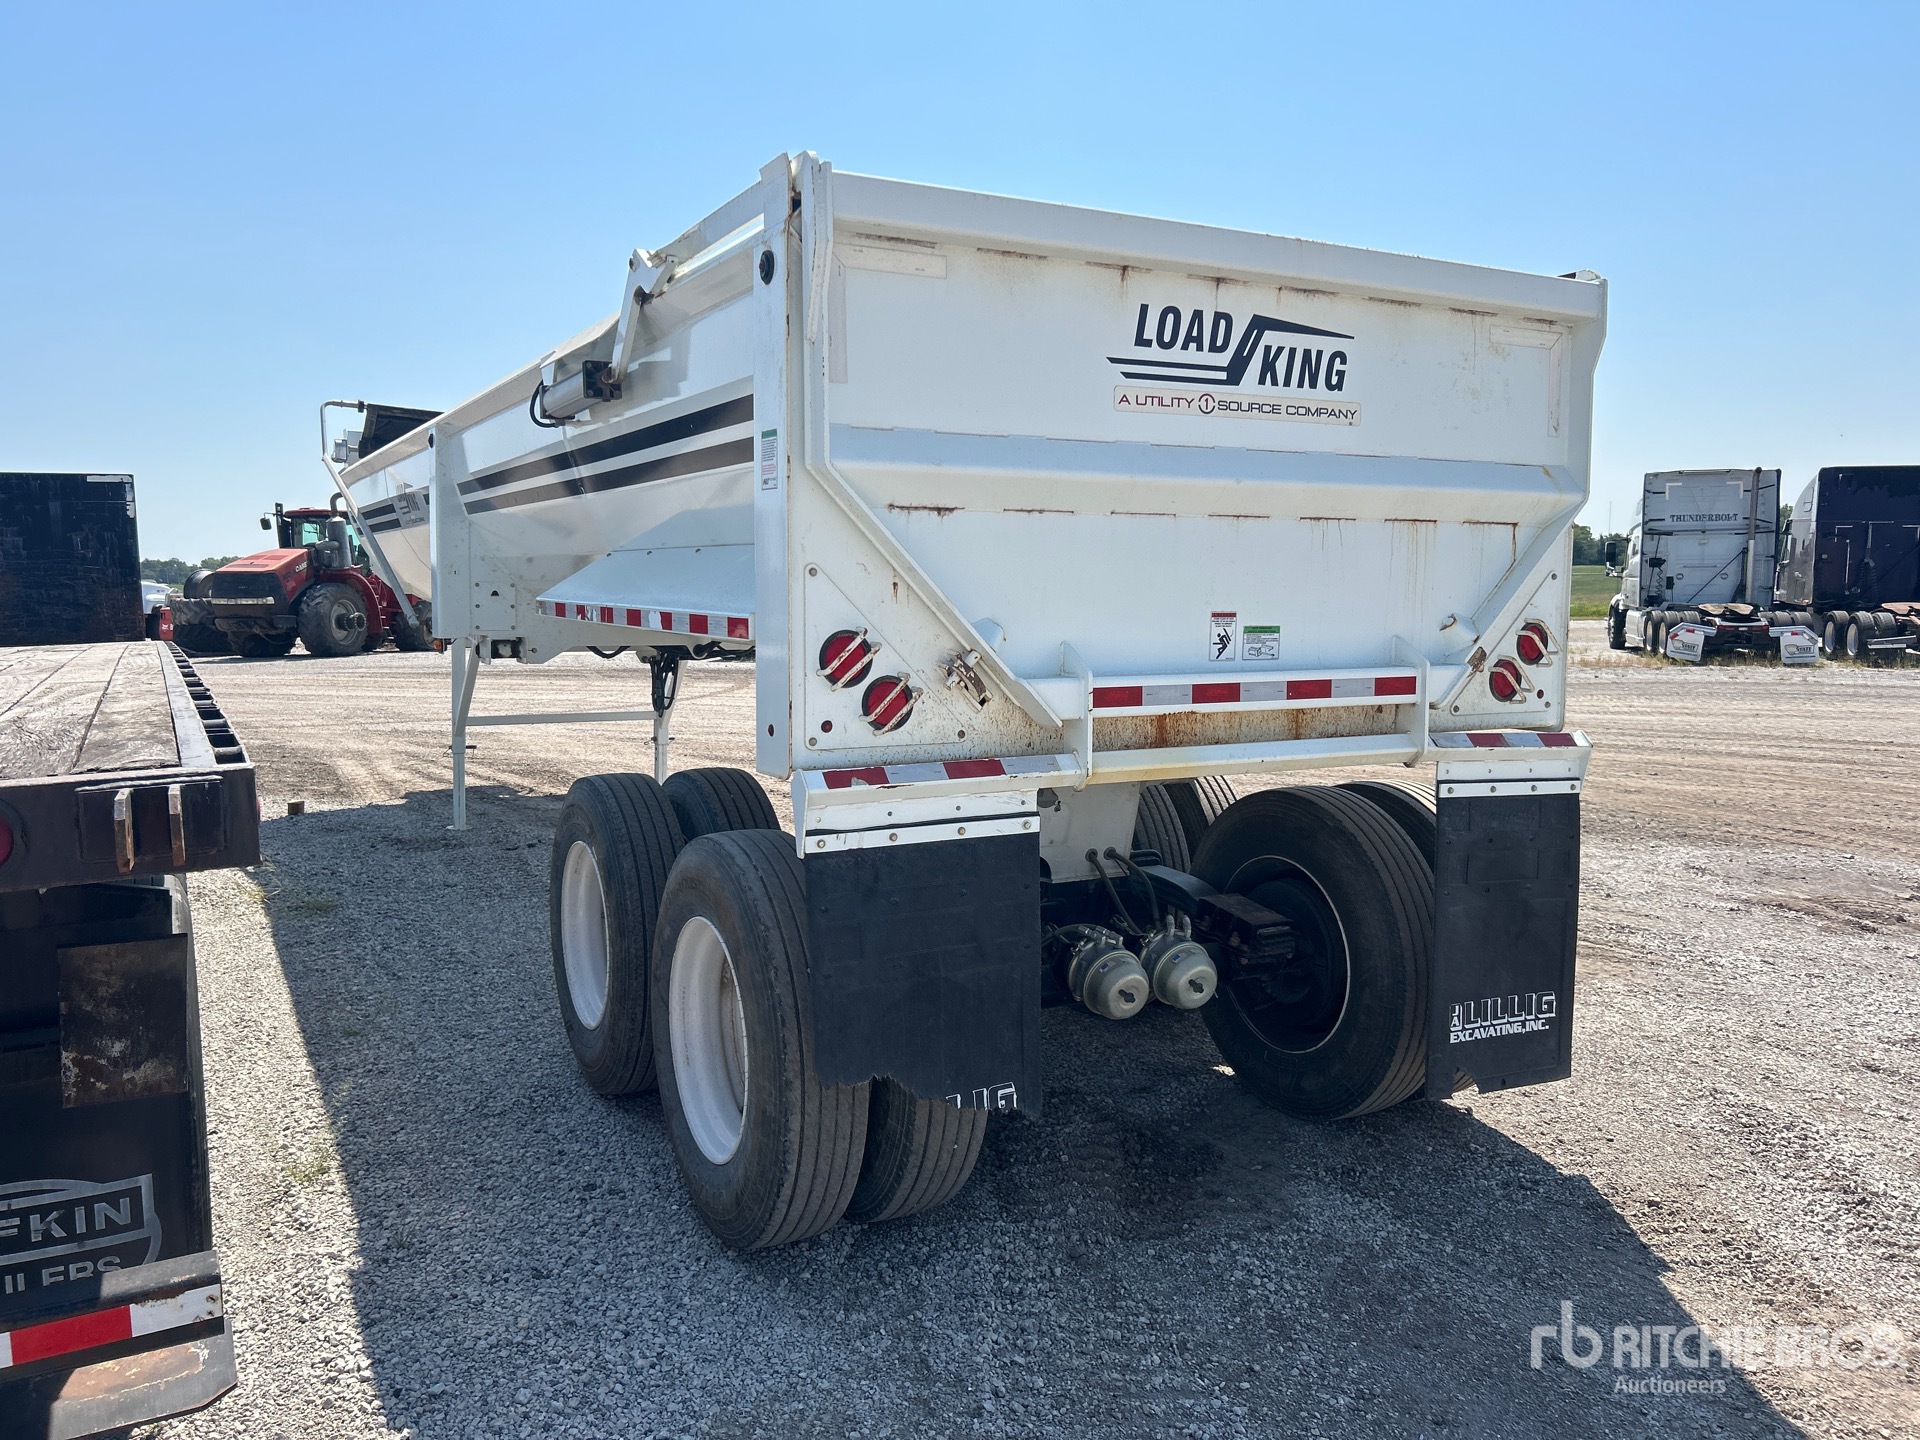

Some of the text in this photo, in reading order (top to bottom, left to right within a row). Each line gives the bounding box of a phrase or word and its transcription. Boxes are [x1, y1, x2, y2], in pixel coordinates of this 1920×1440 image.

[1134, 303, 1233, 354] LOAD
[1257, 344, 1348, 392] KING
[1118, 394, 1131, 405] A
[1136, 395, 1195, 408] UTILITY
[1217, 400, 1282, 415] SOURCE
[1285, 404, 1358, 420] COMPANY
[1669, 513, 1739, 523] THUNDERBOLT
[1464, 991, 1556, 1028] LILLIG
